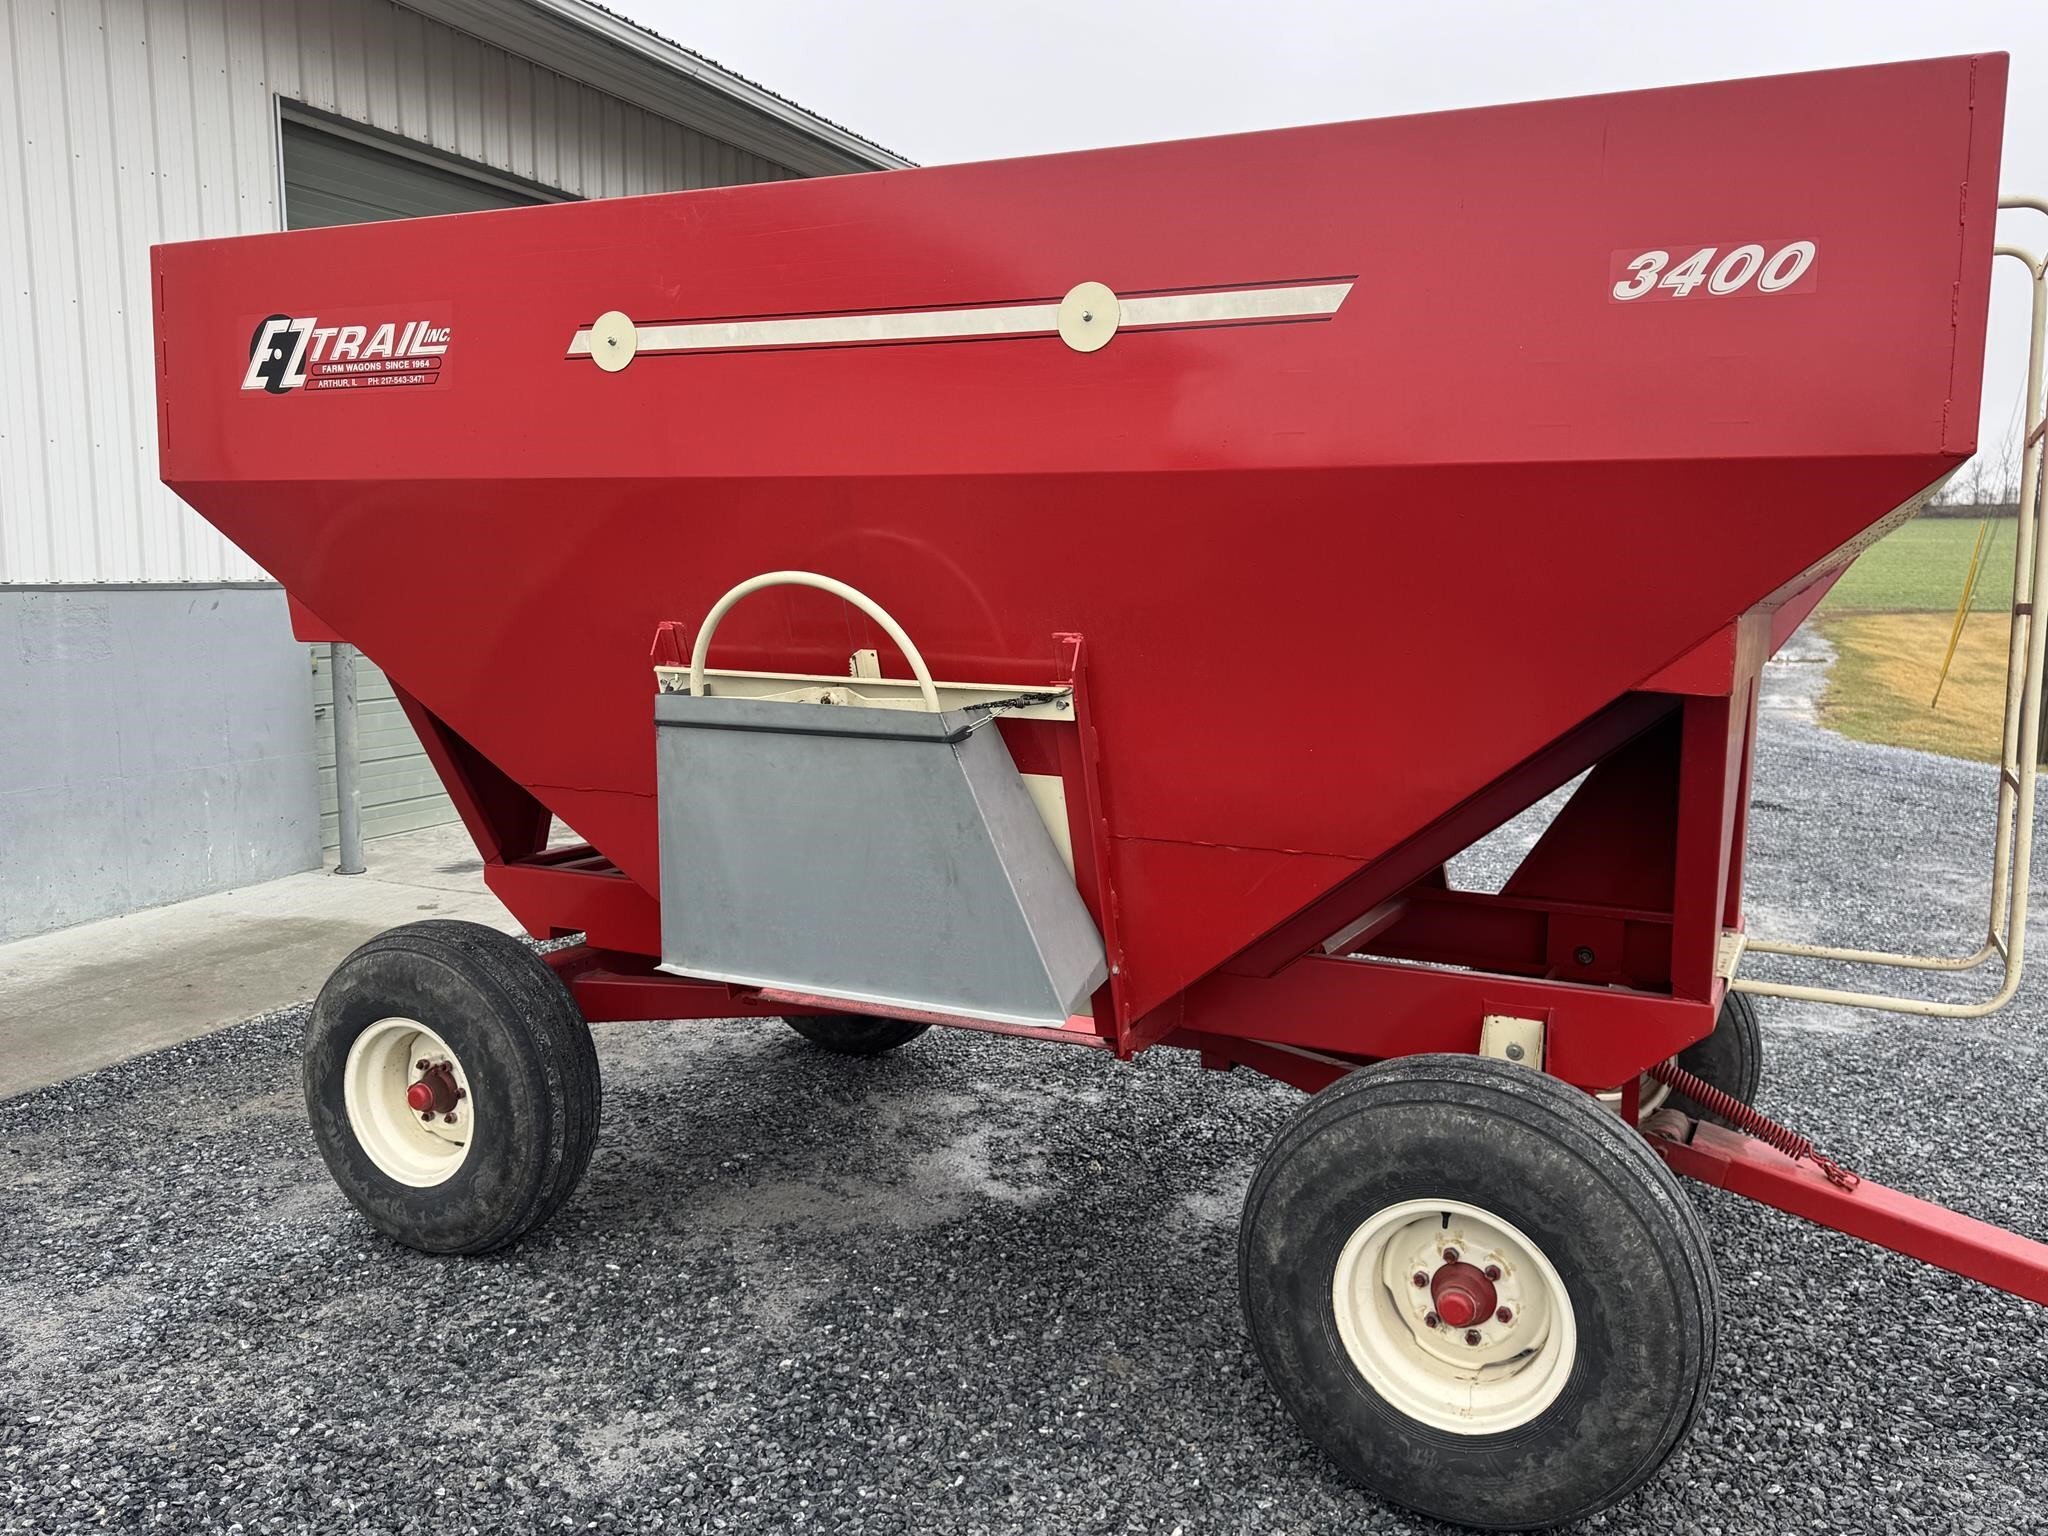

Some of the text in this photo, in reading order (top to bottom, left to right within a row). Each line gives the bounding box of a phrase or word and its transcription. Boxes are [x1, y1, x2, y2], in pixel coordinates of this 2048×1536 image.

[1612, 240, 1816, 301] 3400
[310, 320, 449, 362] TRAIL
[322, 359, 430, 374] FARM WAGONS SINCE 1964
[351, 378, 358, 387] IL
[380, 375, 425, 385] 217-543-3471
